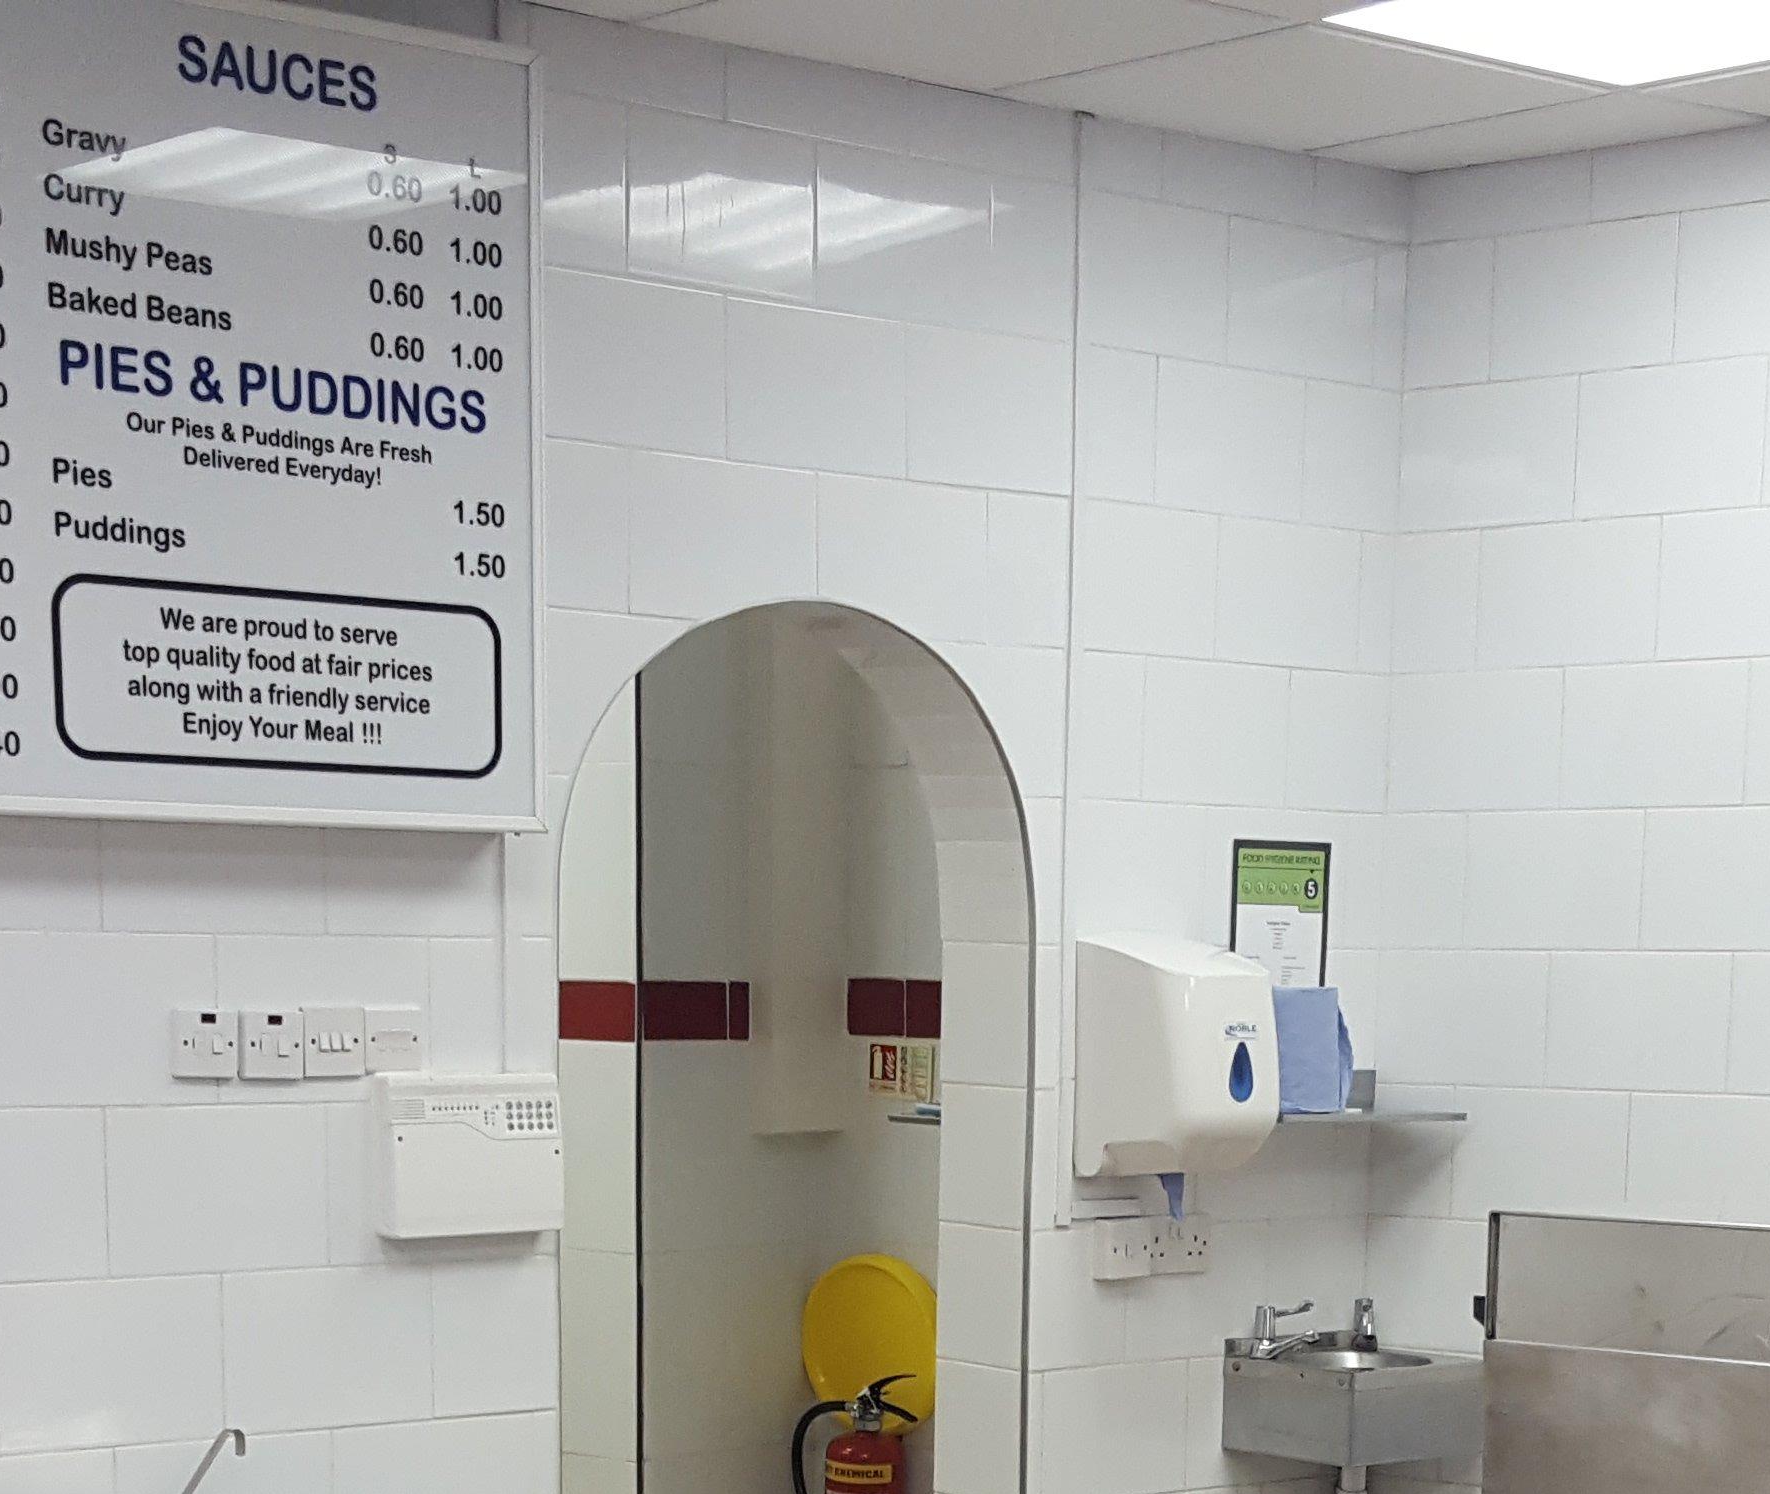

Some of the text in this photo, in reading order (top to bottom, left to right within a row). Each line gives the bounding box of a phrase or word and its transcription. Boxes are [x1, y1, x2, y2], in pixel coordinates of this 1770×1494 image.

[178, 35, 377, 112] SAUCES
[42, 118, 502, 215] Gravy 1.00
[43, 173, 502, 268] Curry 0.60 1.00
[45, 227, 213, 276] Mushy Peas
[48, 282, 232, 331] Baked Beans
[59, 339, 486, 434] PIES & PUDDINGS
[126, 412, 432, 464] Our Pies & Puddings Are Fresh
[184, 446, 381, 489] Delivered Everyday!
[52, 457, 505, 528] Pies 1.50
[54, 511, 505, 579] Puddings 1.50
[160, 607, 397, 646] We are proud to serve
[123, 640, 433, 683] top quality food at fair prices
[128, 675, 430, 715] along with a friendly service
[183, 712, 382, 744] Enjoy Your Meal !!!
[1307, 881, 1317, 898] 5
